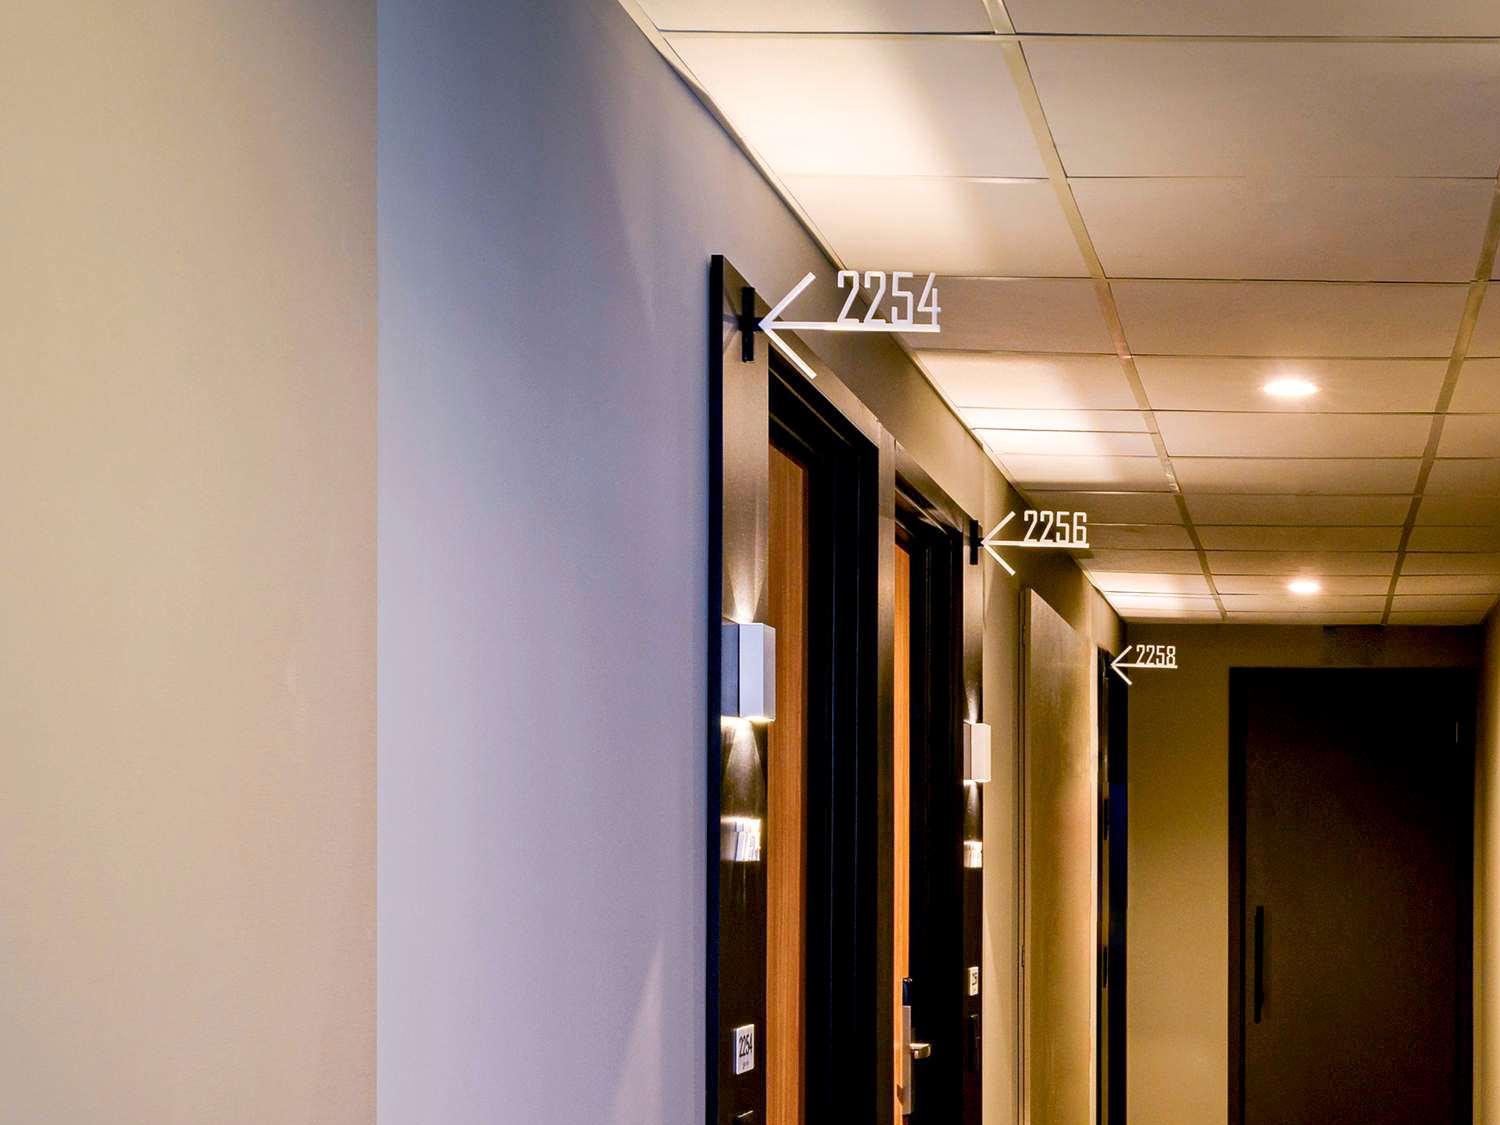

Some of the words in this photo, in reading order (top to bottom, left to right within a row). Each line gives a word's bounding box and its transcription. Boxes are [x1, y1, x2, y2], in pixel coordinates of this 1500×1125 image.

[837, 270, 942, 328] 2254
[1023, 510, 1088, 546] 2256
[1136, 644, 1176, 667] 2258
